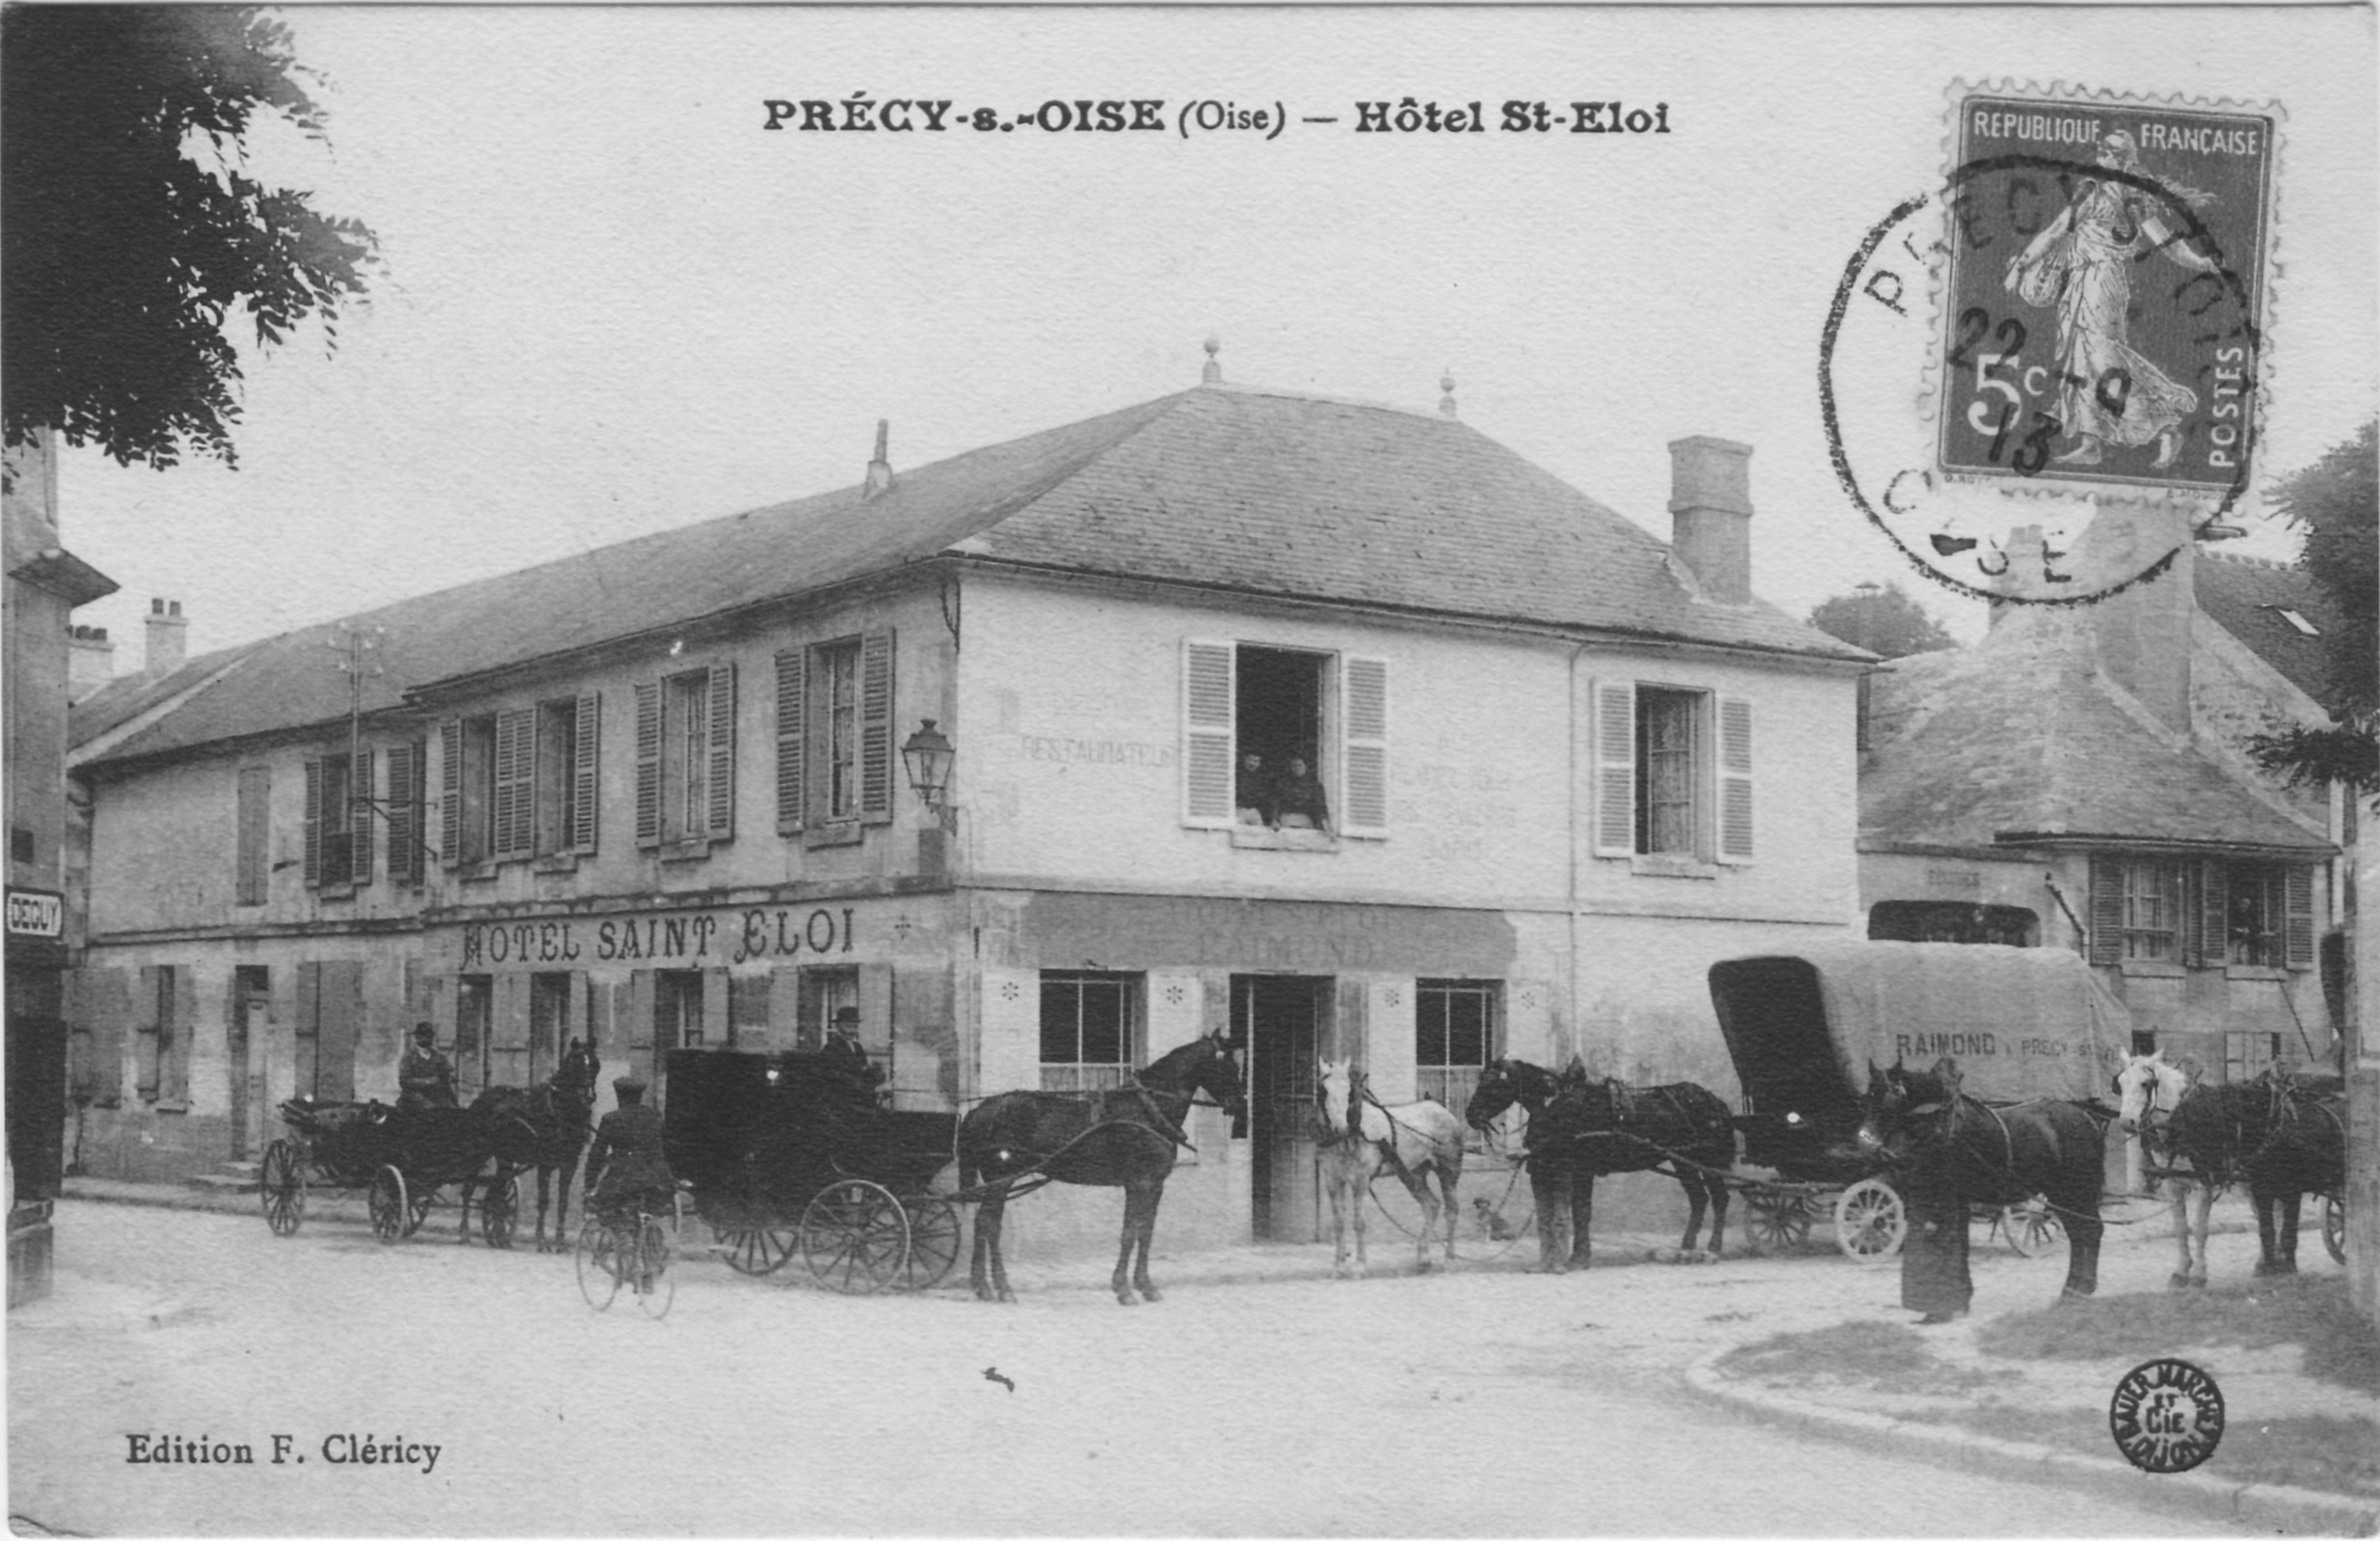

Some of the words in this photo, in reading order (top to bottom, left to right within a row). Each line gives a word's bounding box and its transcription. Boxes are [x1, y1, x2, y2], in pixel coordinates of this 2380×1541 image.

[2140, 122, 2258, 156] FRANÇAISE
[2207, 346, 2245, 469] POSTES
[460, 921, 581, 971] HOTEL
[597, 914, 717, 960] SAINT
[733, 907, 856, 964] ELOI
[1896, 1033, 1996, 1057] RAIMOND
